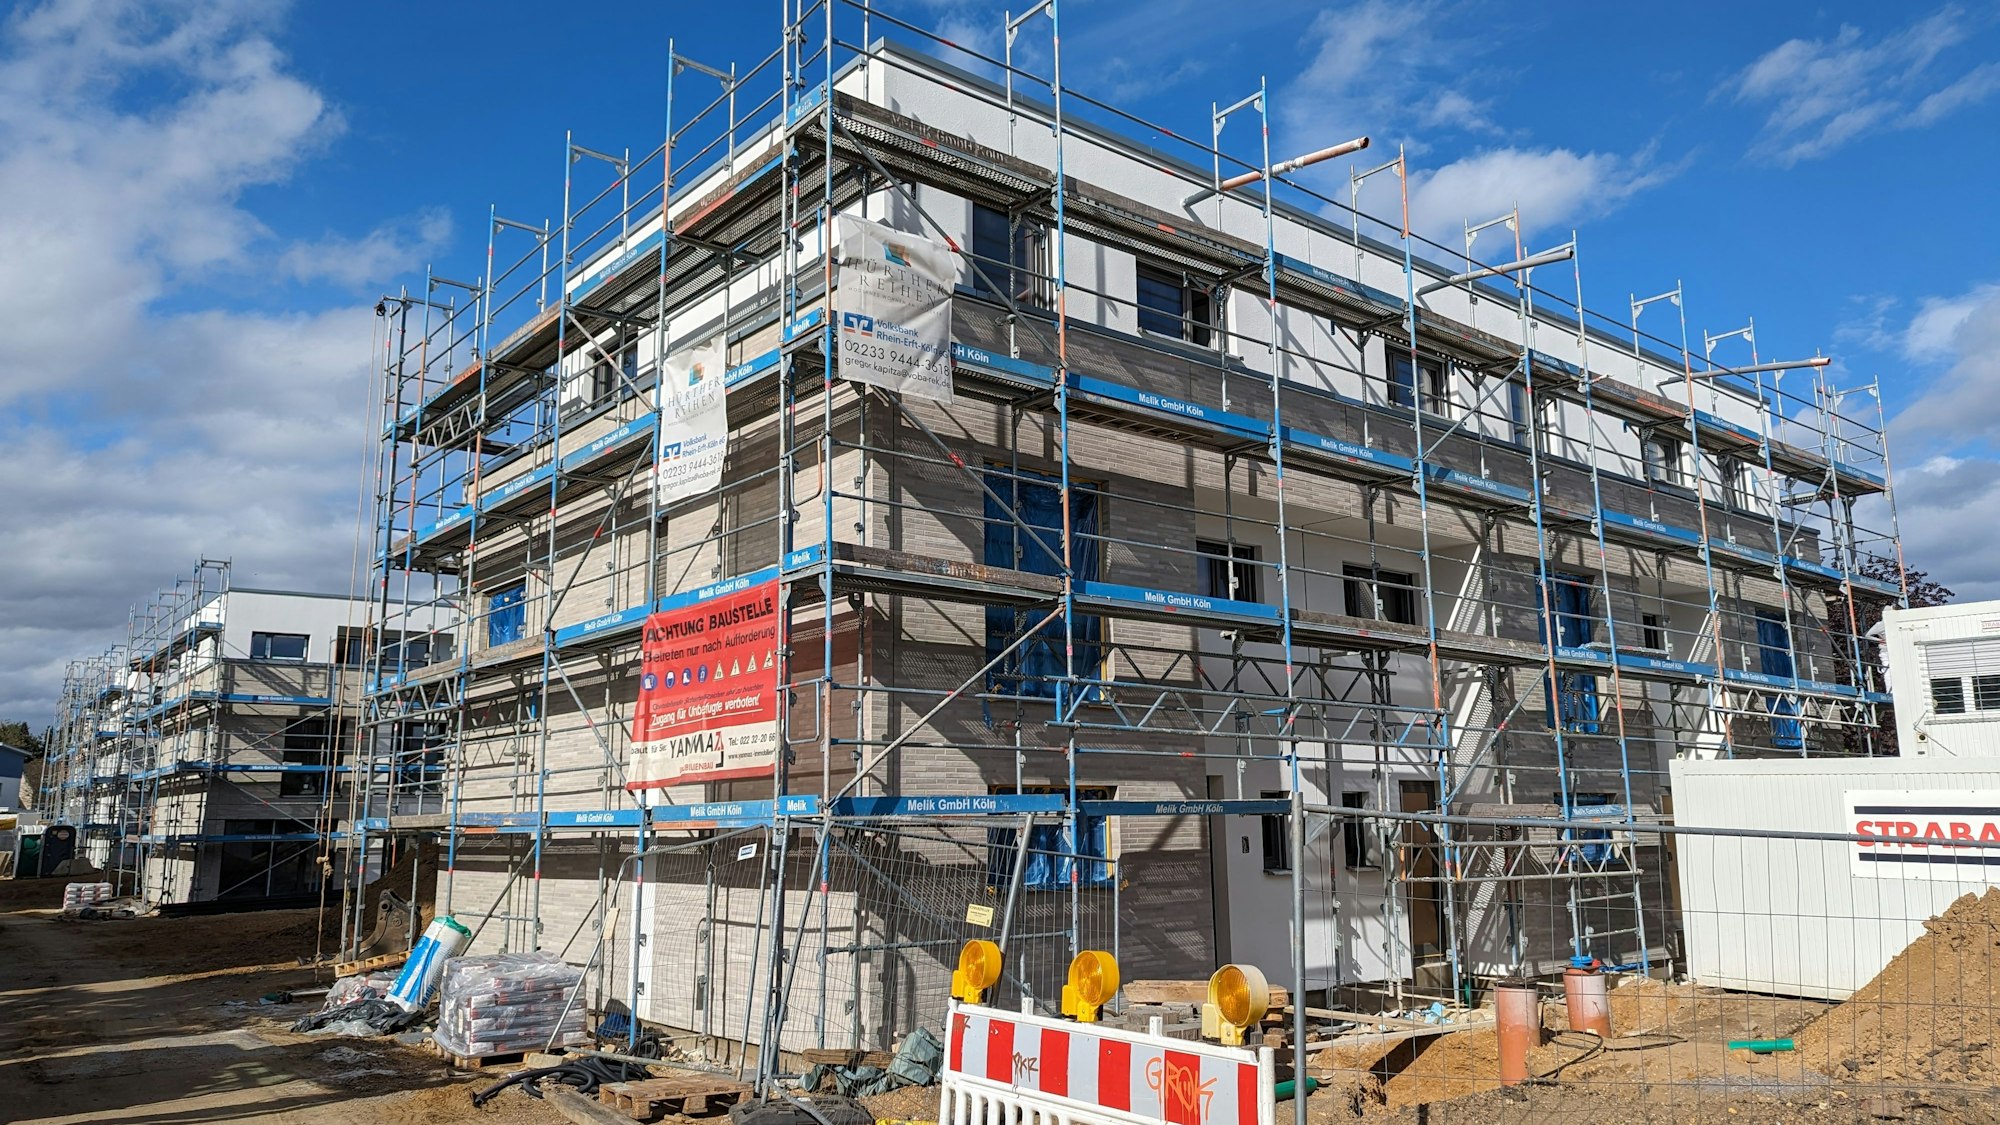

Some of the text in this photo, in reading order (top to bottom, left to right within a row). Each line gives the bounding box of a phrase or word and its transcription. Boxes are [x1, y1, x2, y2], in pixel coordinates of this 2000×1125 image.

[847, 257, 946, 296] HÜRTHER
[860, 274, 936, 307] REIHEN
[792, 318, 810, 337] Melik
[877, 319, 919, 338] Volksbank
[877, 331, 938, 354] Rhein-Erft-Köln
[844, 339, 950, 377] 02233 9444-3618
[952, 345, 989, 364] bH Köln
[724, 364, 752, 385] mbH Köln
[845, 356, 950, 389] gregor.kapitza@voba-rek.de
[668, 376, 720, 407] HÜRTHER
[1138, 392, 1204, 417] Melik GmbH Köln
[1321, 438, 1374, 459] Melik GmbH Köln
[663, 467, 687, 480] 02233
[791, 551, 810, 566] Melik
[699, 578, 750, 600] Melik GmbH Köln
[1144, 591, 1211, 609] Melik GmbH Köln
[645, 597, 773, 644] ACHTUNG BAUSTELLE
[687, 645, 699, 658] nur
[703, 638, 722, 653] nach
[725, 626, 776, 648] Aufforderung
[651, 711, 676, 727] Zugang
[677, 708, 686, 719] für
[688, 700, 722, 718] Unbefugte
[725, 693, 760, 711] verboten!
[740, 735, 750, 745] 022
[690, 803, 742, 817] Melik GmbH Köln
[787, 799, 807, 811] Melik
[907, 797, 996, 811] Melik GmbH Köln
[1155, 803, 1224, 814] Melik GmbH Köln
